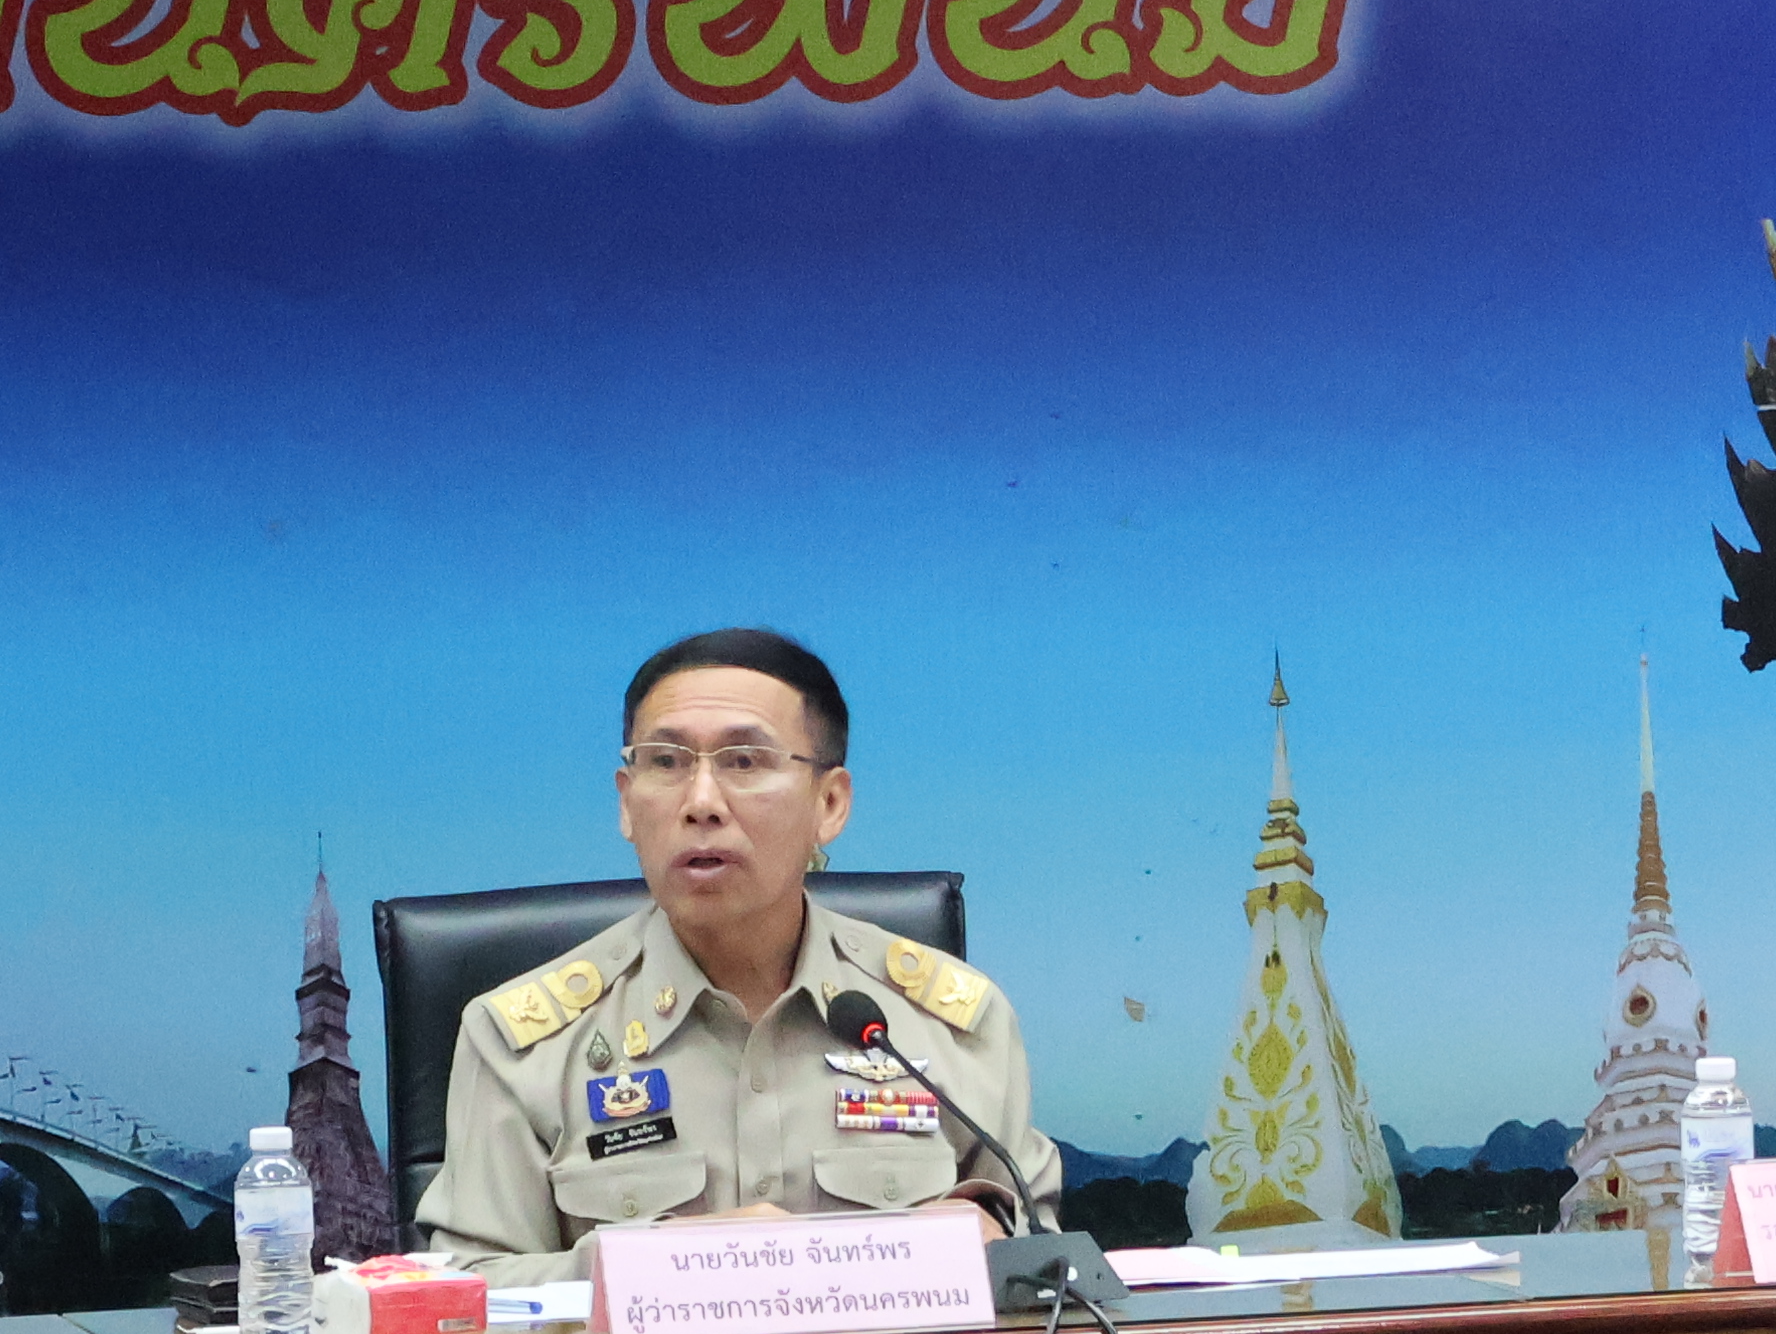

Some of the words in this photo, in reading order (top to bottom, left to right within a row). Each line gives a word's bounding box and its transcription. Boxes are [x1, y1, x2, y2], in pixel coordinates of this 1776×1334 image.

[671, 1239, 795, 1272] นายวันชัย
[806, 1233, 912, 1265] จันทร์พร
[627, 1284, 970, 1334] ผู้ว่าราชการจังหวัดนครพนม
